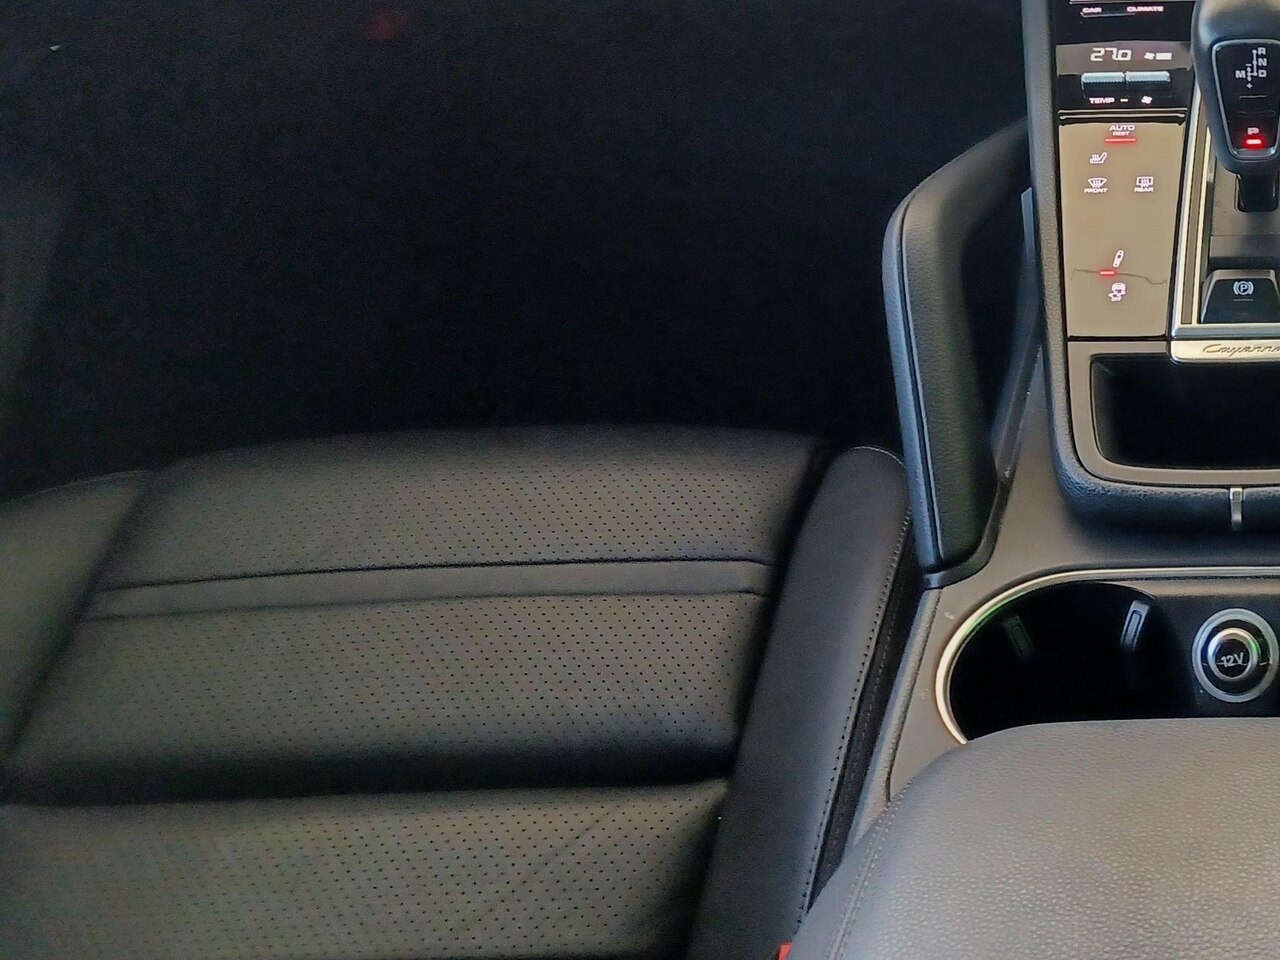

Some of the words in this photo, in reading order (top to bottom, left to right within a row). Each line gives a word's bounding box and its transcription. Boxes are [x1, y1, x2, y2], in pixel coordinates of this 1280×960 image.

[1257, 47, 1266, 55] R
[1258, 58, 1267, 66] N
[1235, 70, 1246, 78] M
[1247, 127, 1260, 135] P
[1220, 652, 1244, 667] 12V
